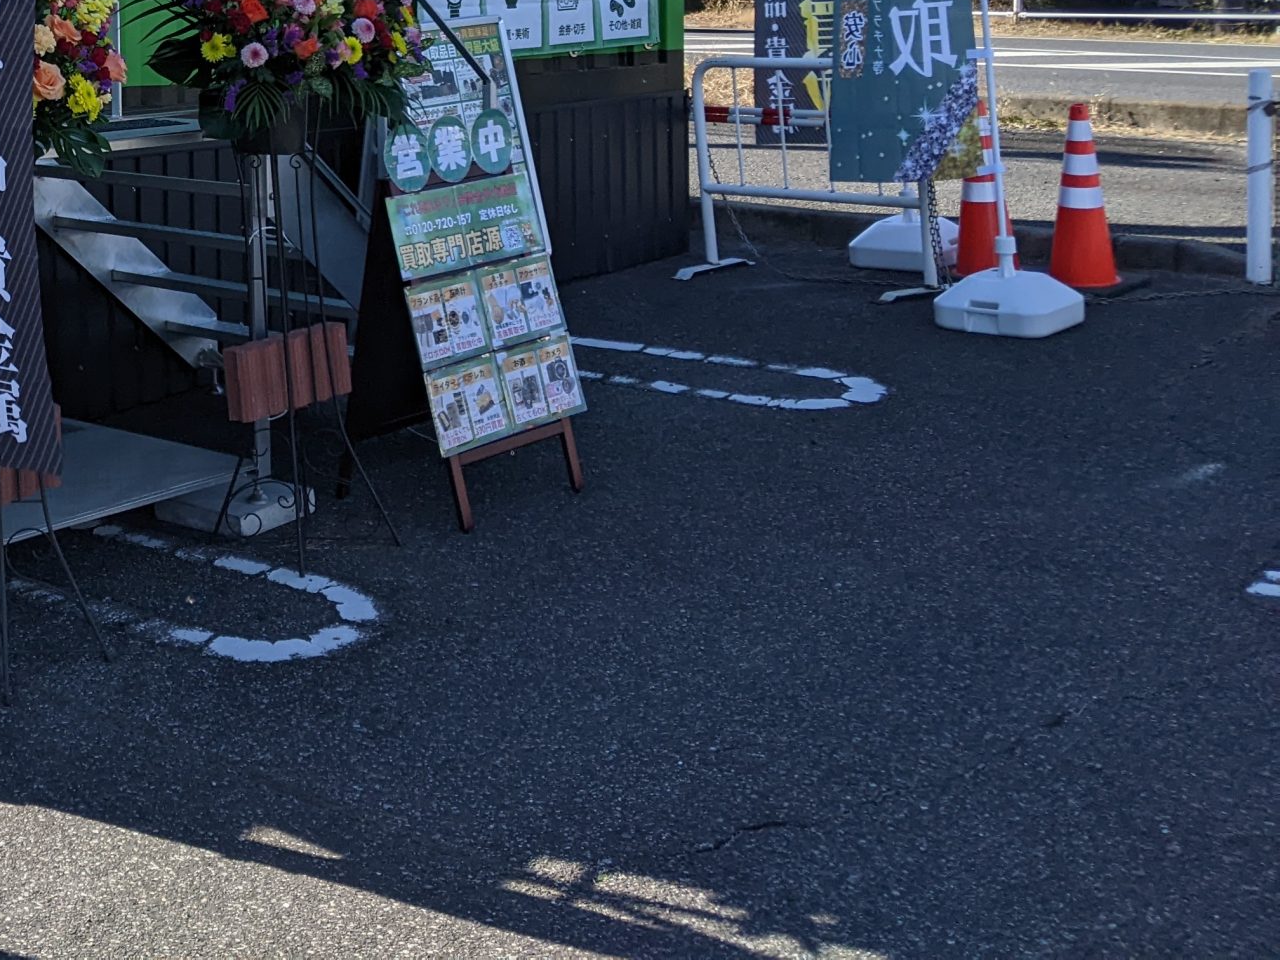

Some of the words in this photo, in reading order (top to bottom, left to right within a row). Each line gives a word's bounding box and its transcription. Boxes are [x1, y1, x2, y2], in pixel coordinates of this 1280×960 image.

[391, 118, 508, 180] 営業中
[399, 225, 504, 271] 買取専門店源
